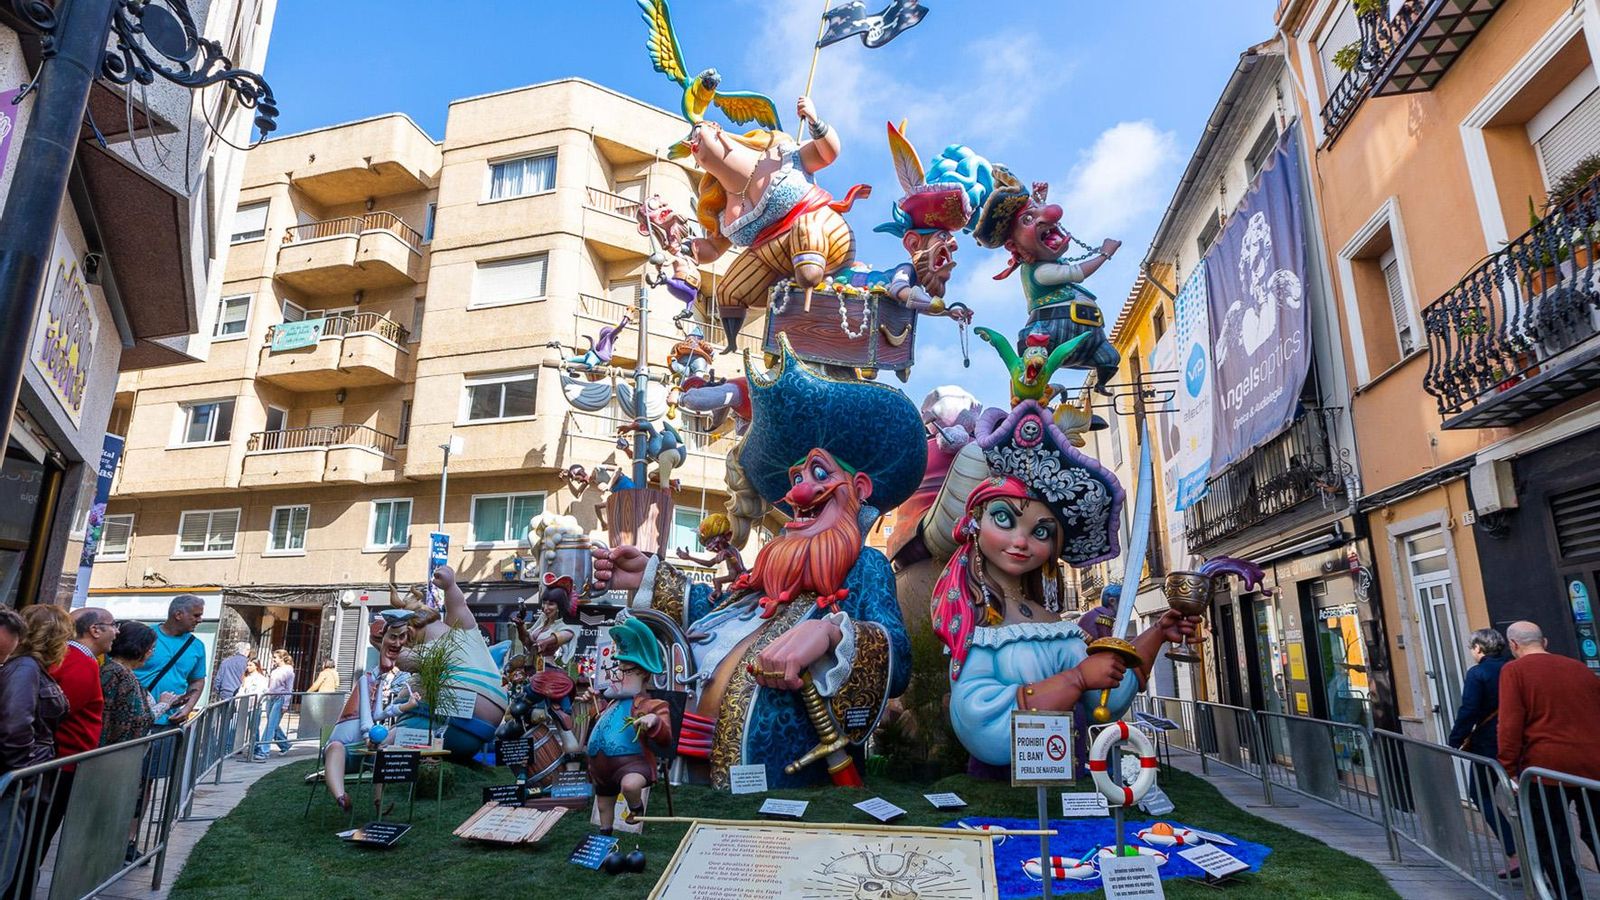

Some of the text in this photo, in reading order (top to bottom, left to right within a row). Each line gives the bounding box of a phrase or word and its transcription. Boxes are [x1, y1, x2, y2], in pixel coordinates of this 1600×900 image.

[1018, 737, 1044, 746] PROHIBIT
[1019, 752, 1043, 760] EL BANY
